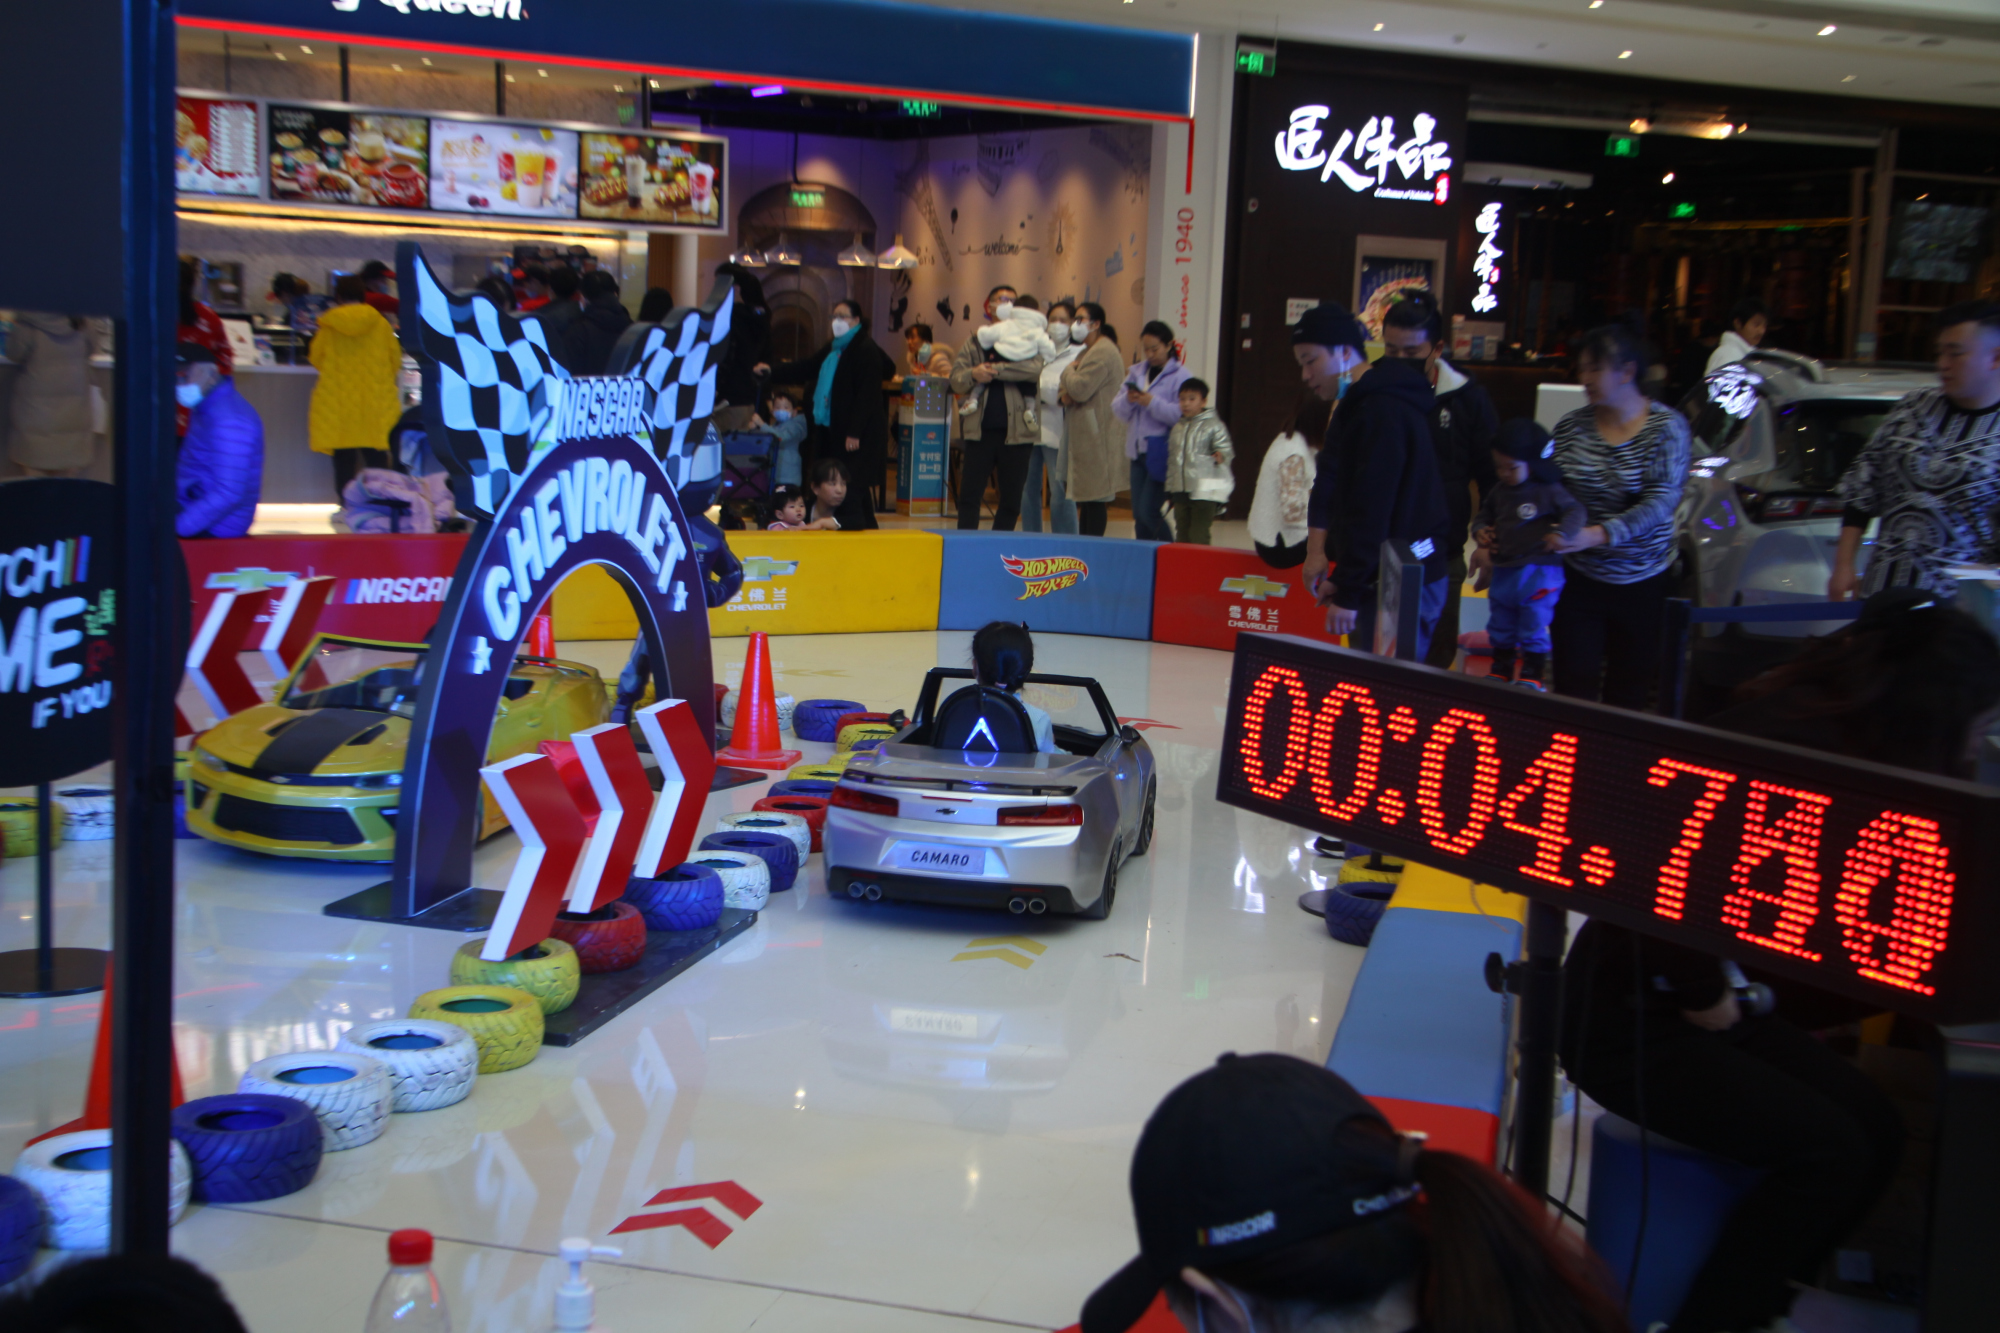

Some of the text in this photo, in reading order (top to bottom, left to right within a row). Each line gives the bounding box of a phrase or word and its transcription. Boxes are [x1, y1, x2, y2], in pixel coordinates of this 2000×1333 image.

[1175, 207, 1194, 265] 1940
[557, 378, 646, 441] NASCAR
[484, 457, 687, 642] CHEVROLET
[727, 603, 786, 612] CHEVROLET
[1229, 605, 1279, 623] 雪佛兰
[1228, 620, 1279, 632] CHEVROLET
[60, 680, 112, 719] YOU
[911, 850, 970, 867] CAMARO
